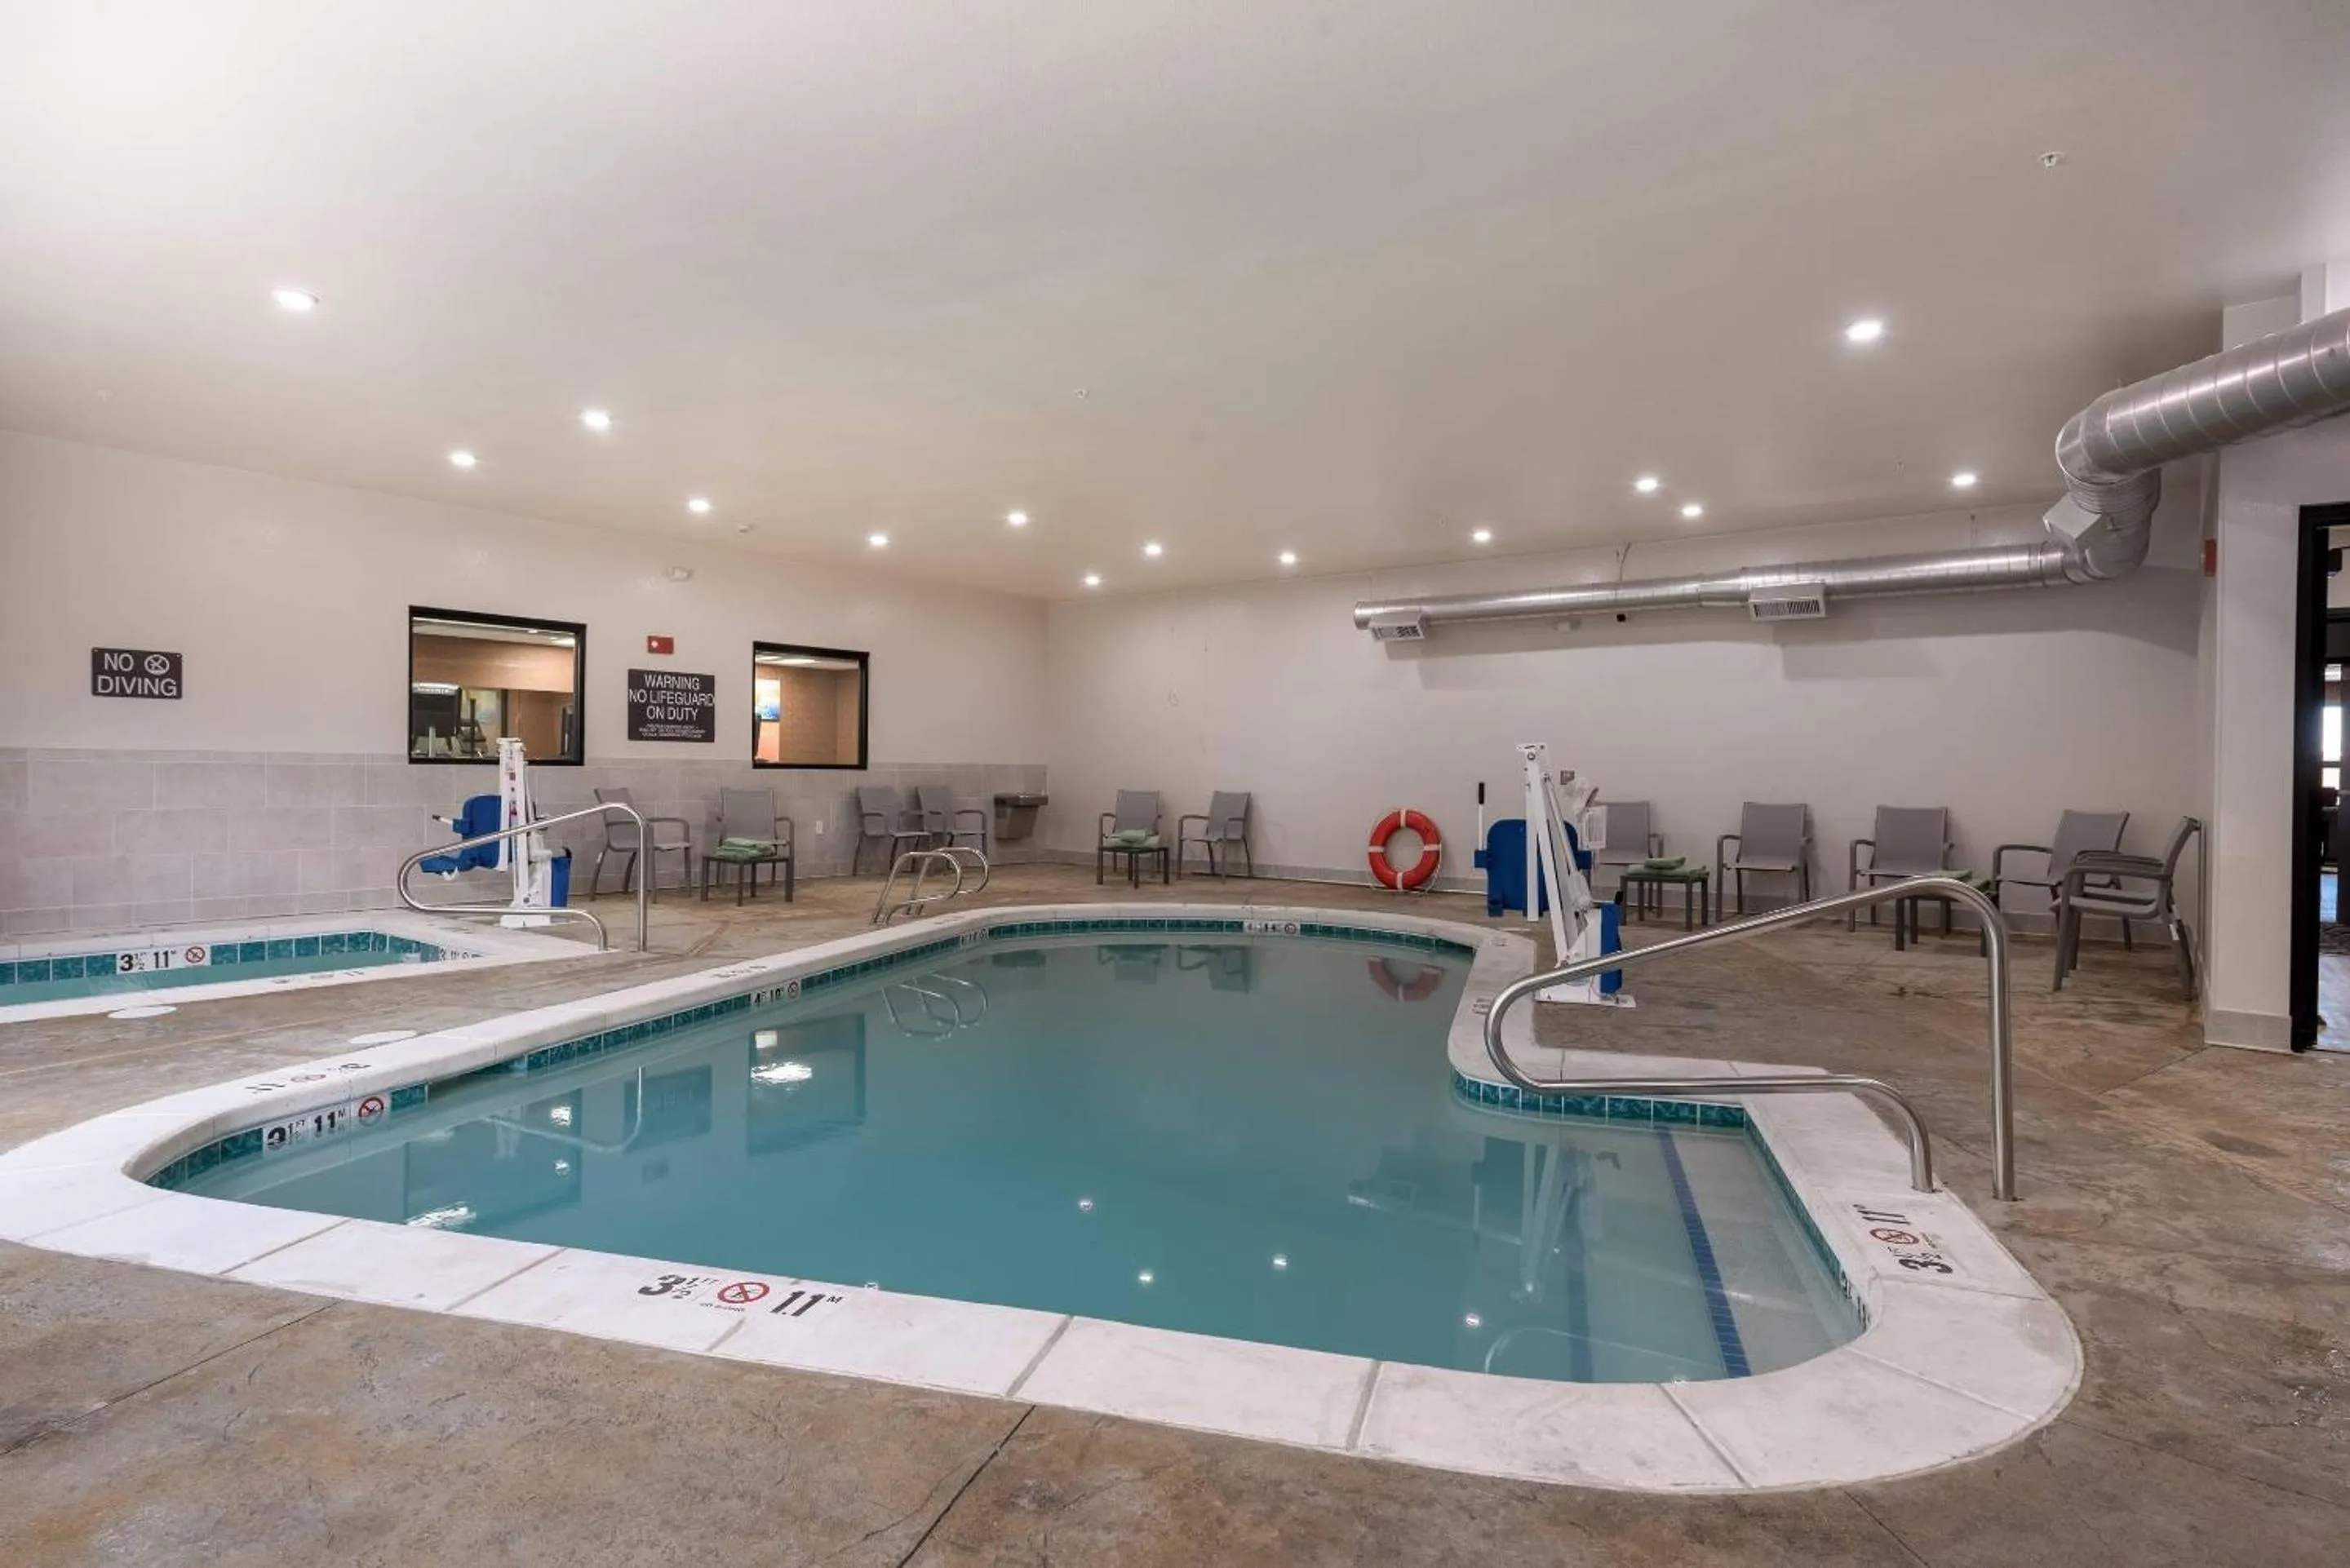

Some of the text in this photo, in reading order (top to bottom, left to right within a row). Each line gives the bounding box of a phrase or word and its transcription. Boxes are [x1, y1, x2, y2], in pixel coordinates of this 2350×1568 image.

[104, 653, 134, 671] NO
[97, 675, 177, 697] DIVING
[644, 673, 701, 690] WARNING
[629, 689, 715, 707] NO LIFEGUARD
[646, 706, 698, 721] ON DUTY
